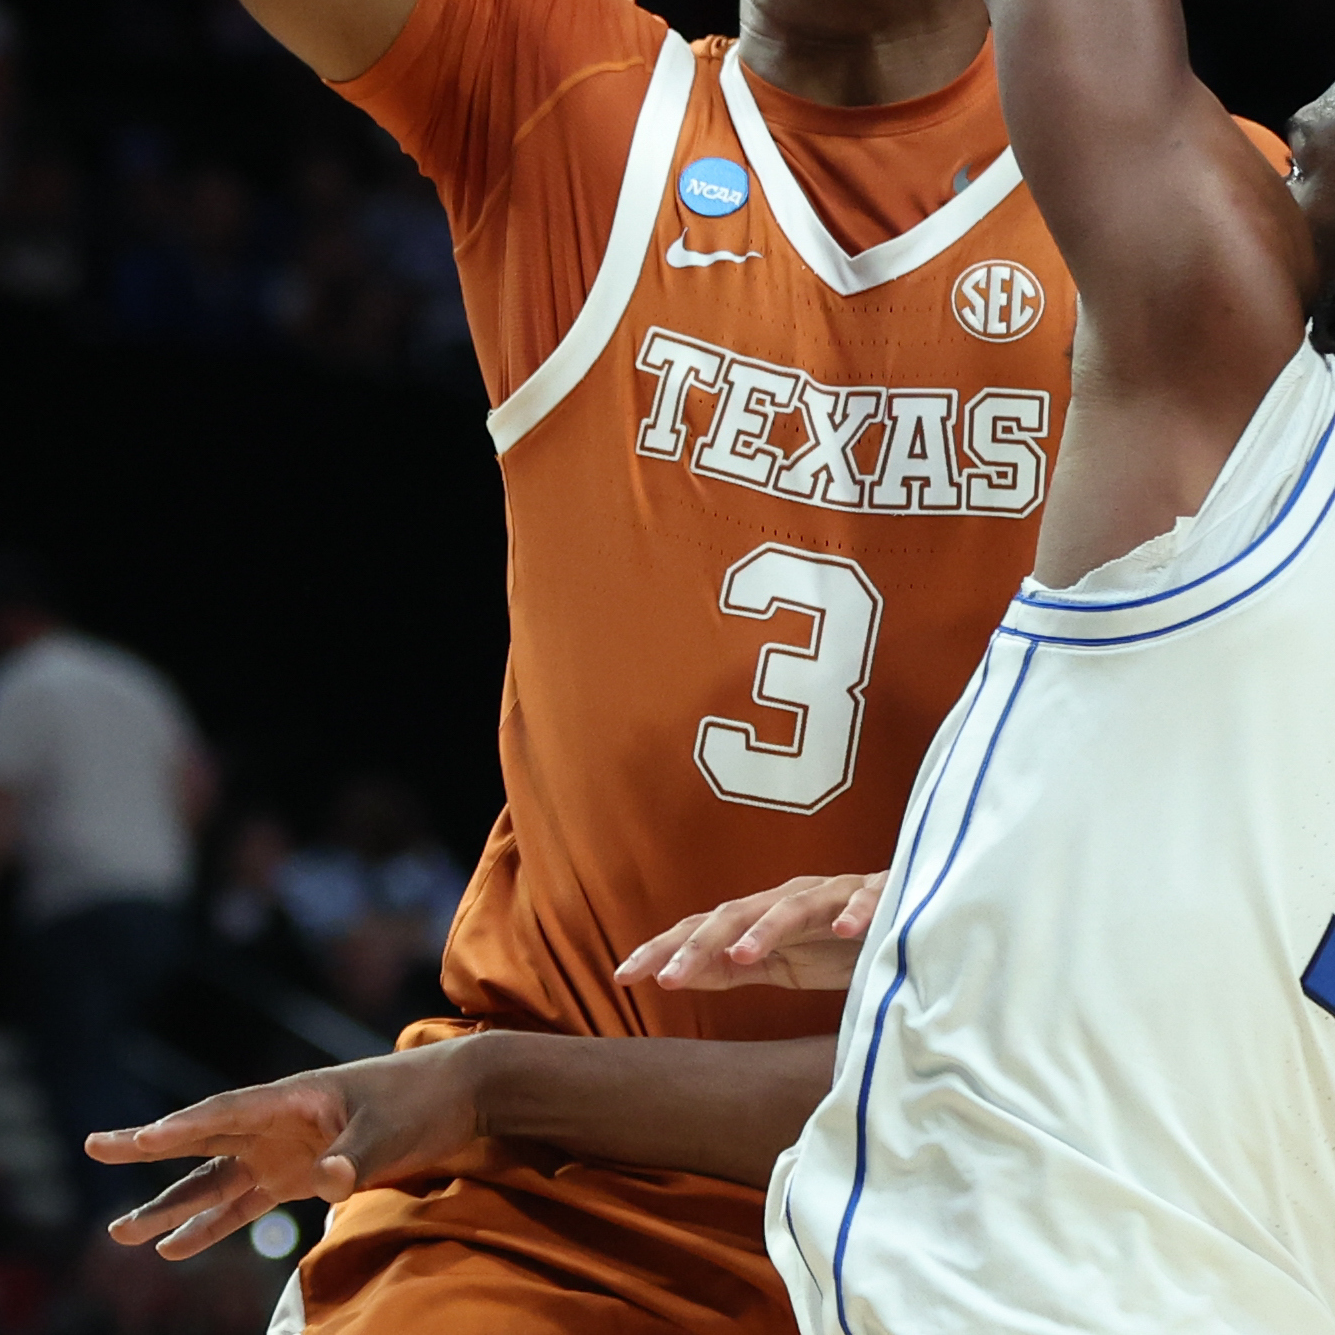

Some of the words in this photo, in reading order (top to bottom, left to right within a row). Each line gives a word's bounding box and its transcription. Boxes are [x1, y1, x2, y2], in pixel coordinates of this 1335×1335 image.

[685, 178, 743, 207] NCAA
[960, 265, 1039, 335] SEC
[636, 325, 1050, 519] TEXAS
[693, 541, 884, 815] 3
